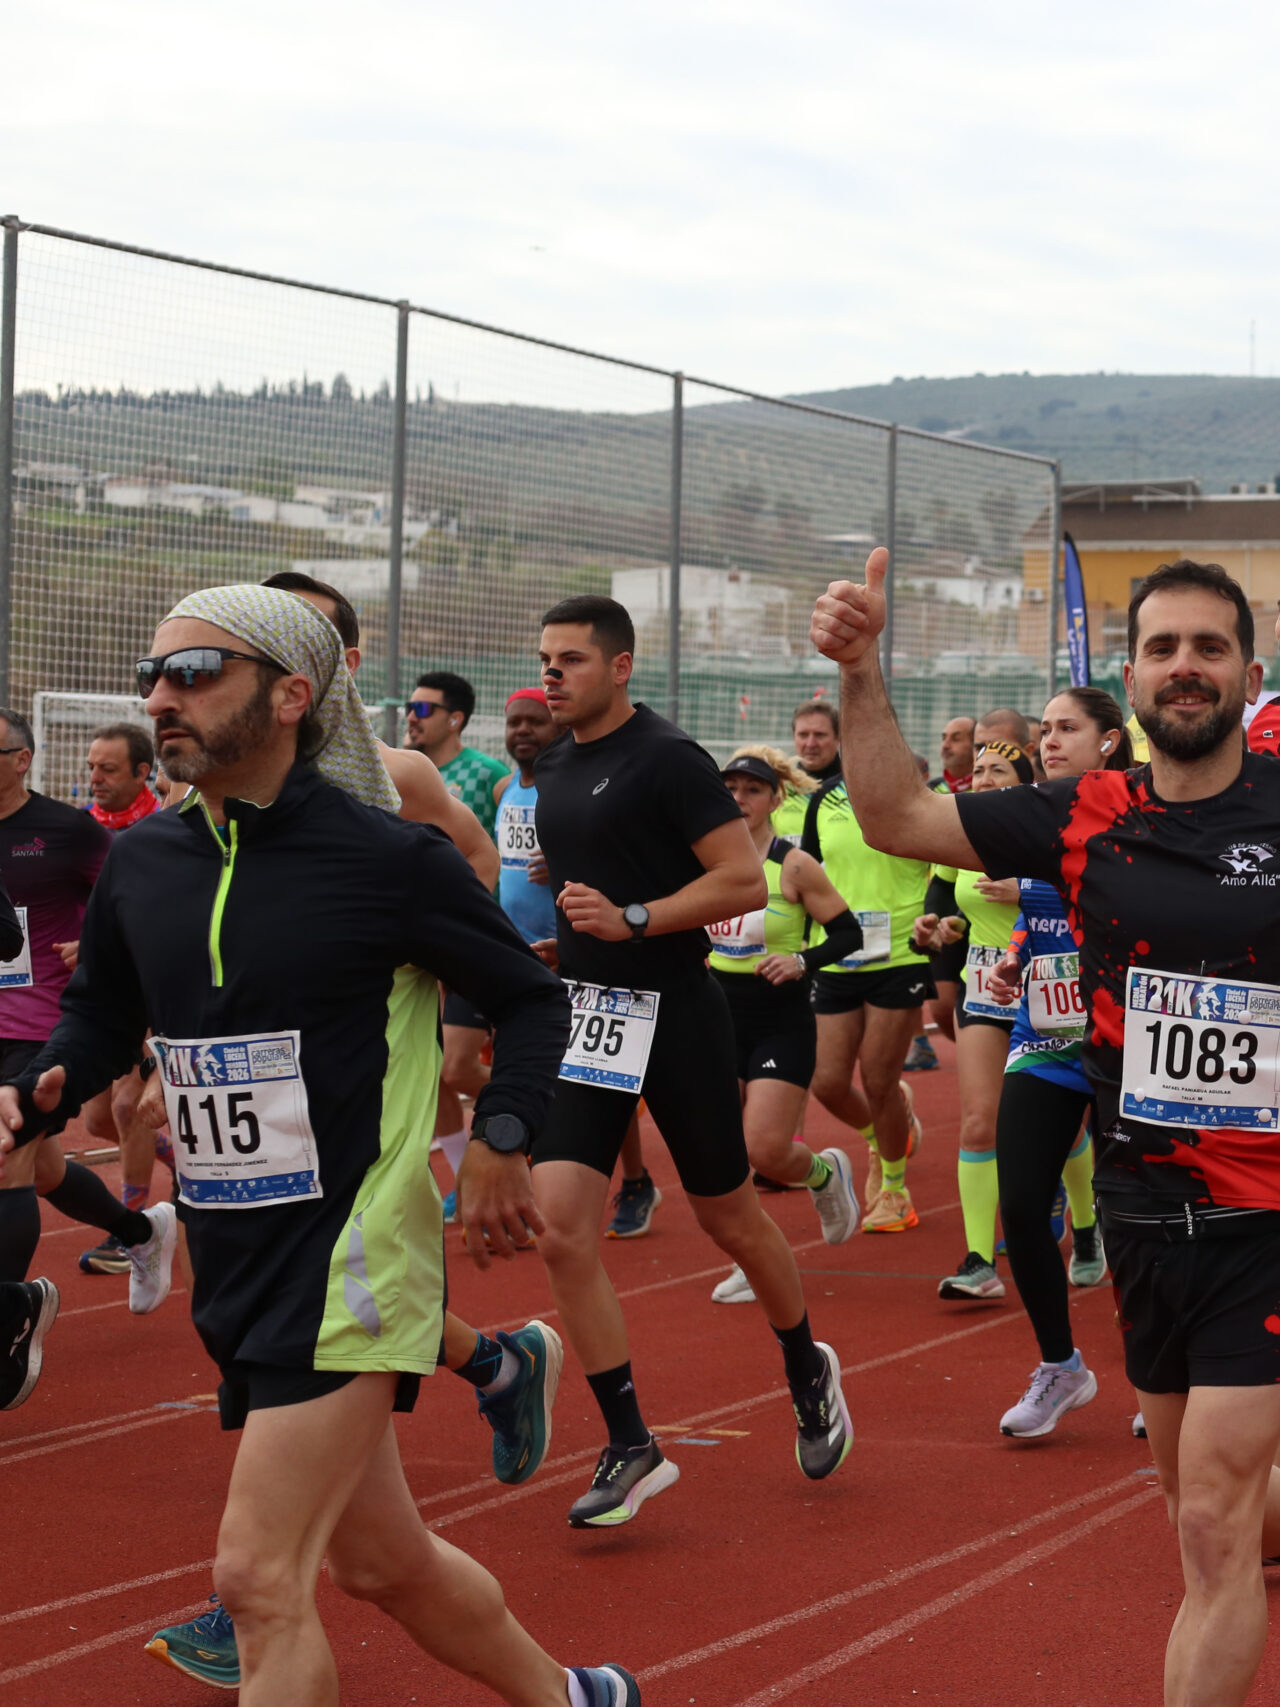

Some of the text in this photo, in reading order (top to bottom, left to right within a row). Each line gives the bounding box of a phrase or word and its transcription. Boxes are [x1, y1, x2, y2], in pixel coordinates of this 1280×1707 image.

[507, 825, 535, 850] 363
[1216, 874, 1280, 886] "Amo Allá"
[1028, 917, 1072, 937] nerp
[1036, 957, 1058, 980] 10K
[1148, 976, 1197, 1017] 21K
[1223, 1009, 1242, 1021] 202
[566, 1013, 626, 1056] 795
[1145, 1020, 1259, 1085] 1083
[168, 1046, 198, 1085] 1K
[227, 1068, 249, 1082] 2026
[178, 1091, 261, 1154] 415
